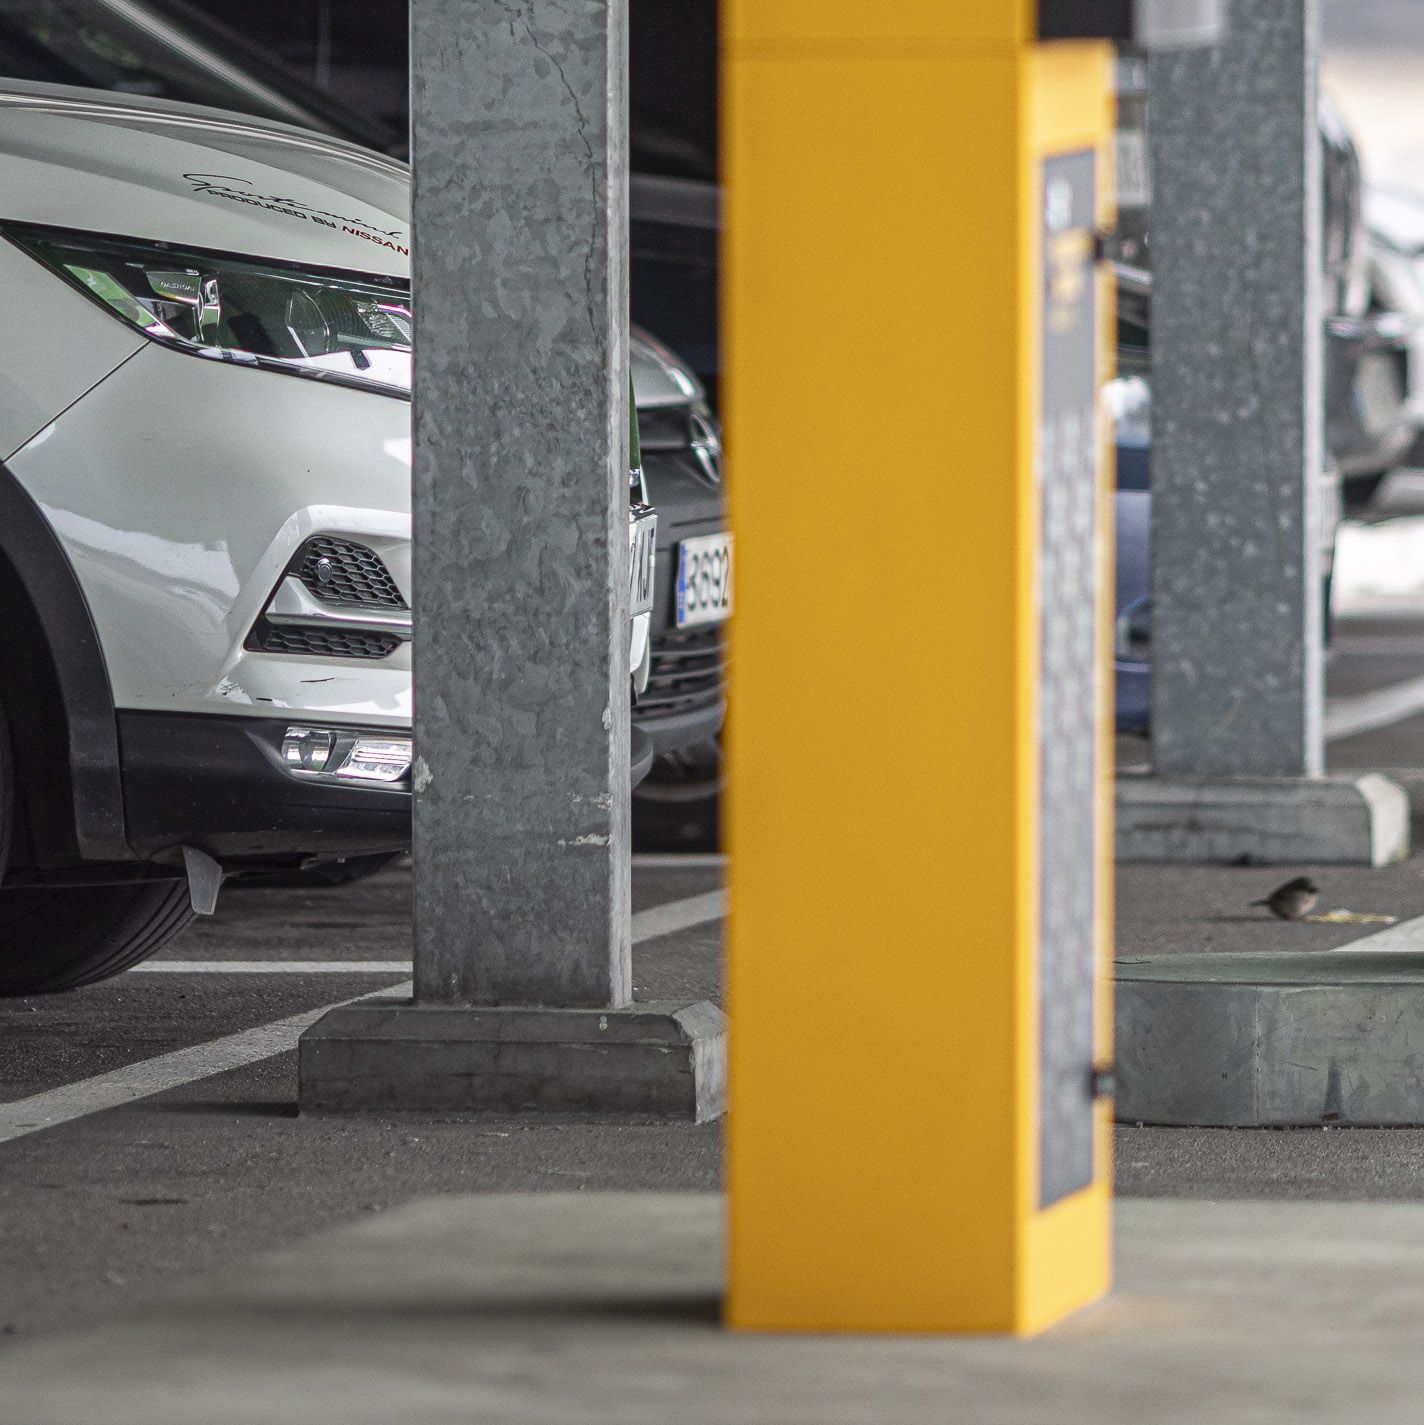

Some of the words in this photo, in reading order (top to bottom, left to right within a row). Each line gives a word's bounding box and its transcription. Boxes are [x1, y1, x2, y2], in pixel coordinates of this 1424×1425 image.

[207, 189, 307, 219] PRODUCED
[311, 216, 337, 229] BY
[342, 226, 408, 256] NISSAN
